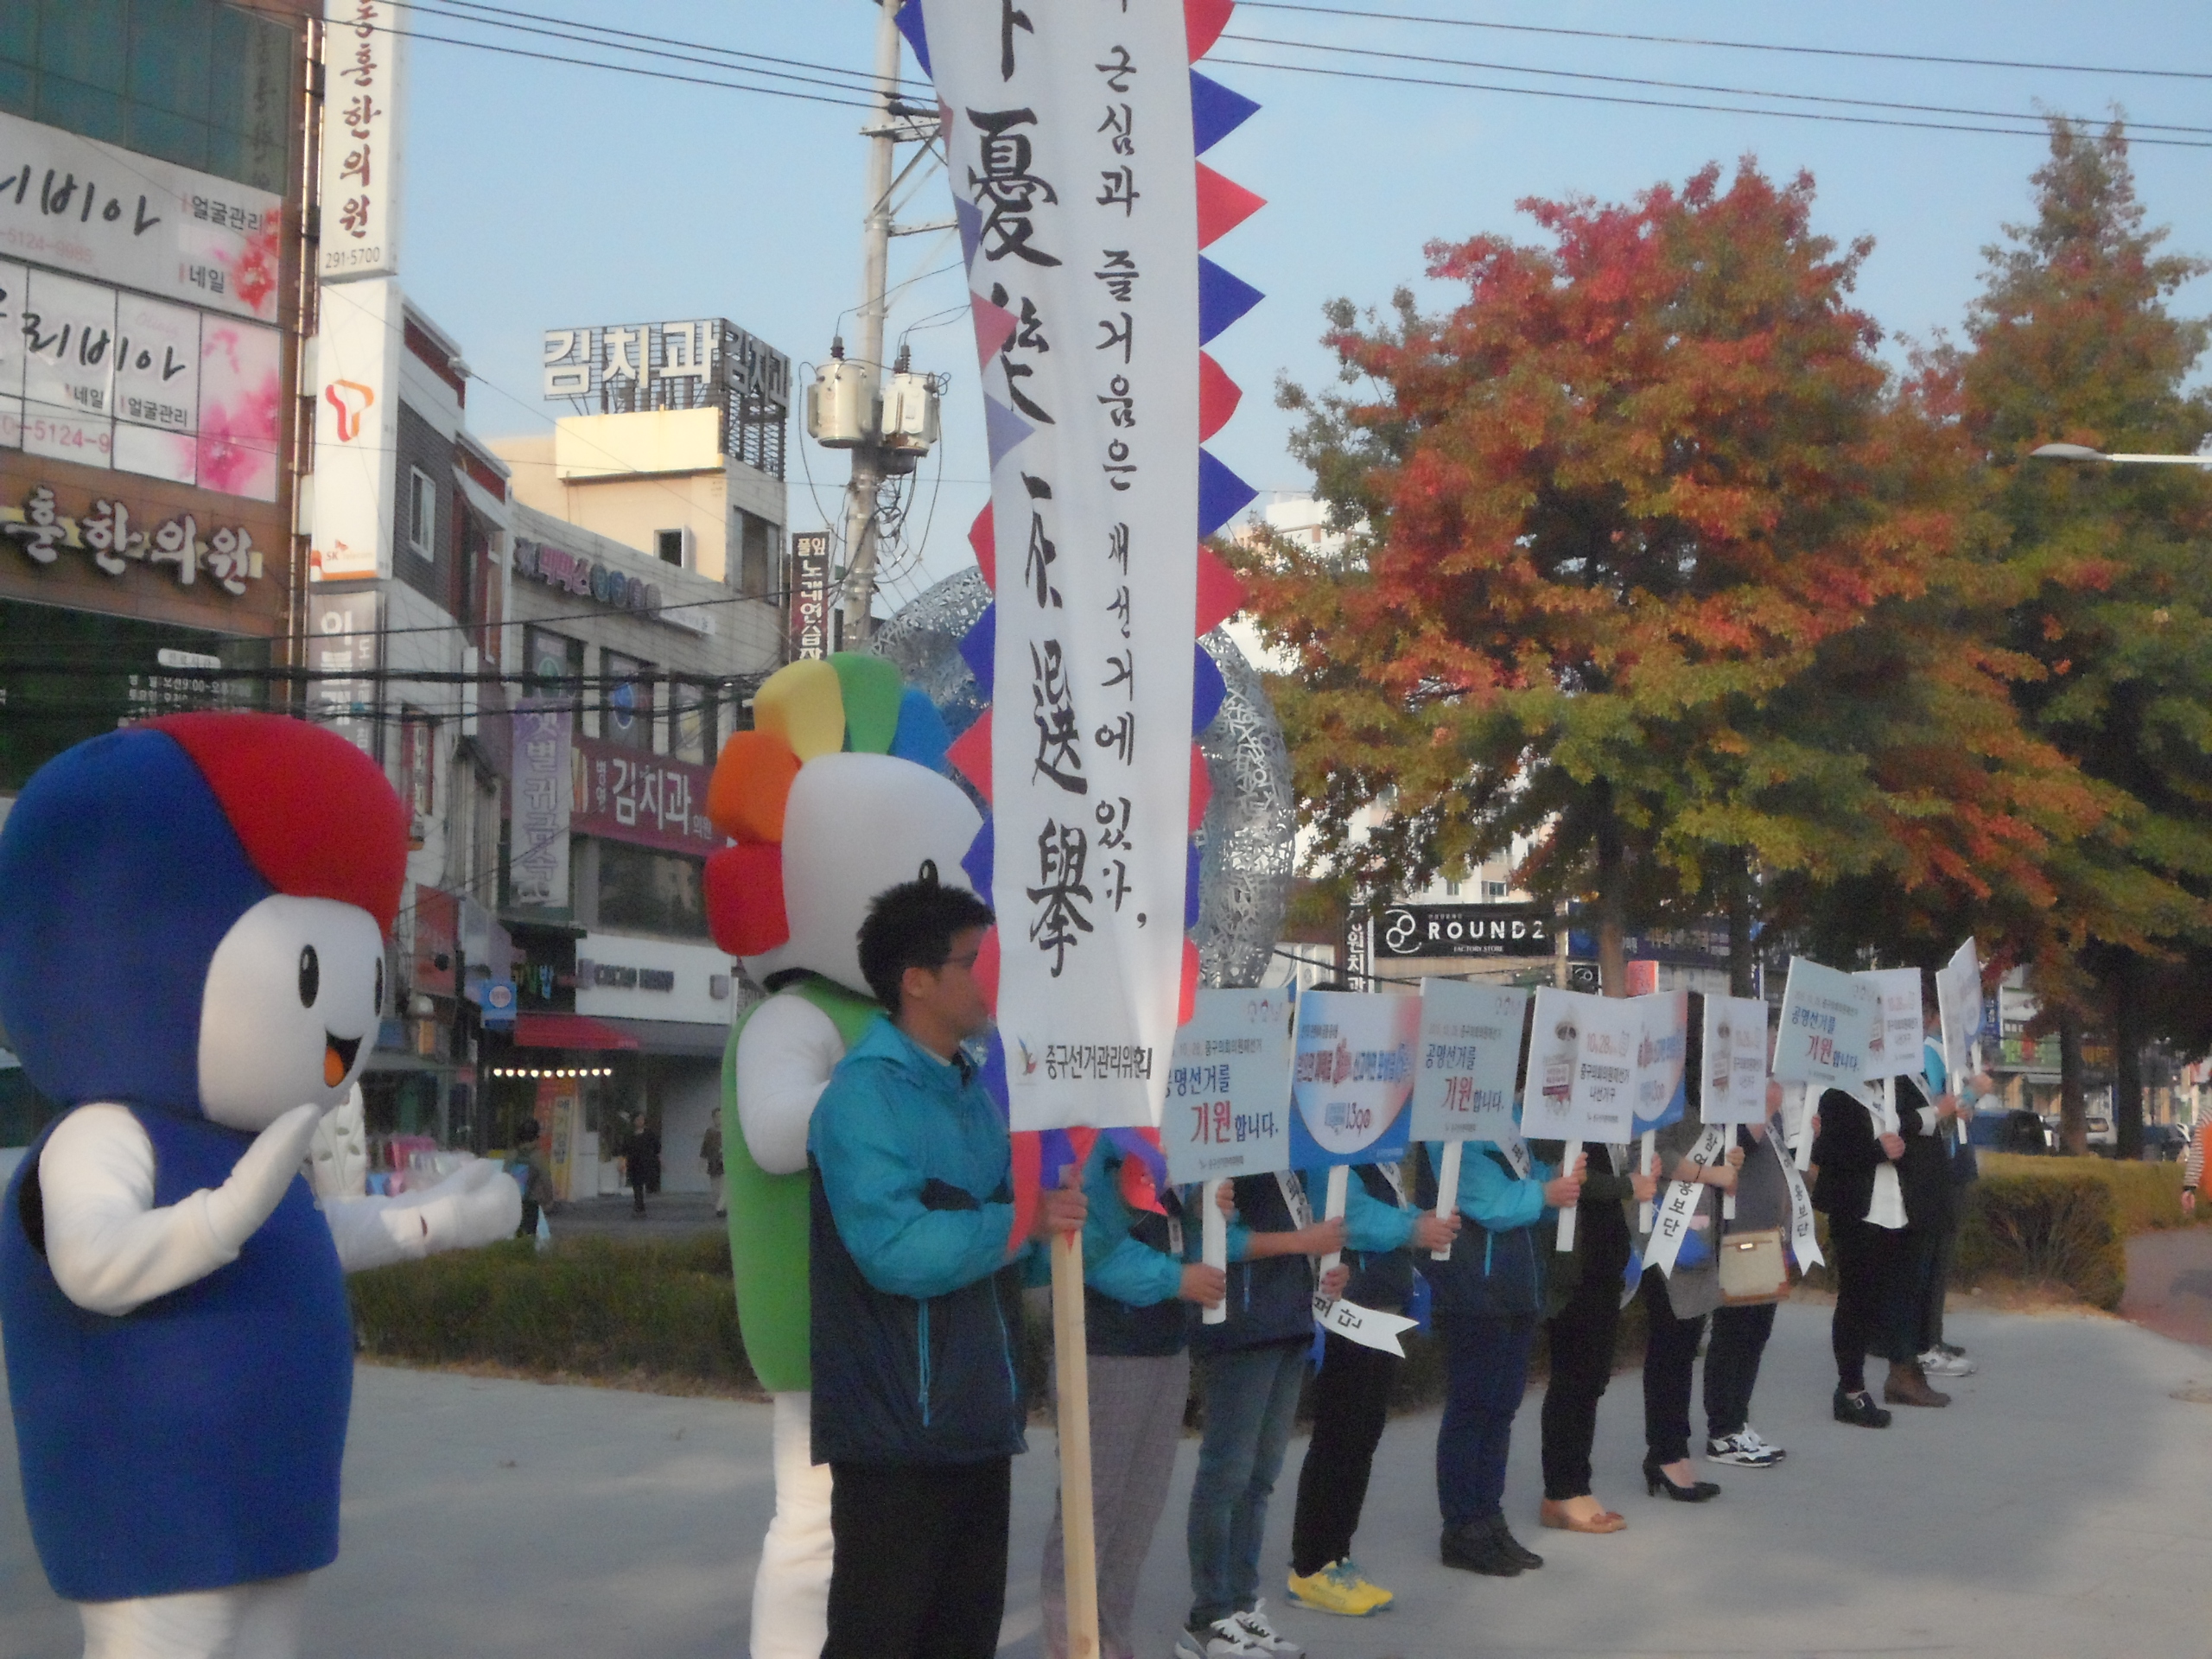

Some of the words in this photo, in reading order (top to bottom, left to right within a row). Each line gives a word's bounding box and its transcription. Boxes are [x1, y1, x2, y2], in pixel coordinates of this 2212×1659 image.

[1094, 45, 1141, 218] 근심과
[192, 194, 264, 232] 얼굴관리
[189, 264, 225, 294] 네일
[0, 289, 186, 381] 리비아
[543, 321, 721, 396] 김치과
[1093, 248, 1141, 492] 즐거움은
[73, 386, 105, 410] 네일
[128, 397, 188, 428] 얼굴관리
[4, 486, 253, 596] 훈한의원
[326, 550, 339, 561] SK
[612, 758, 692, 836] 김치과
[1791, 1006, 1836, 1035] 공명선거를
[1045, 1044, 1154, 1080] 중구선거관리위회
[1426, 1043, 1477, 1071] 공명선거를
[1441, 1076, 1504, 1113] 기원합니다.
[1191, 1099, 1279, 1146] 기원합니다.
[1313, 1296, 1363, 1331] 보단
